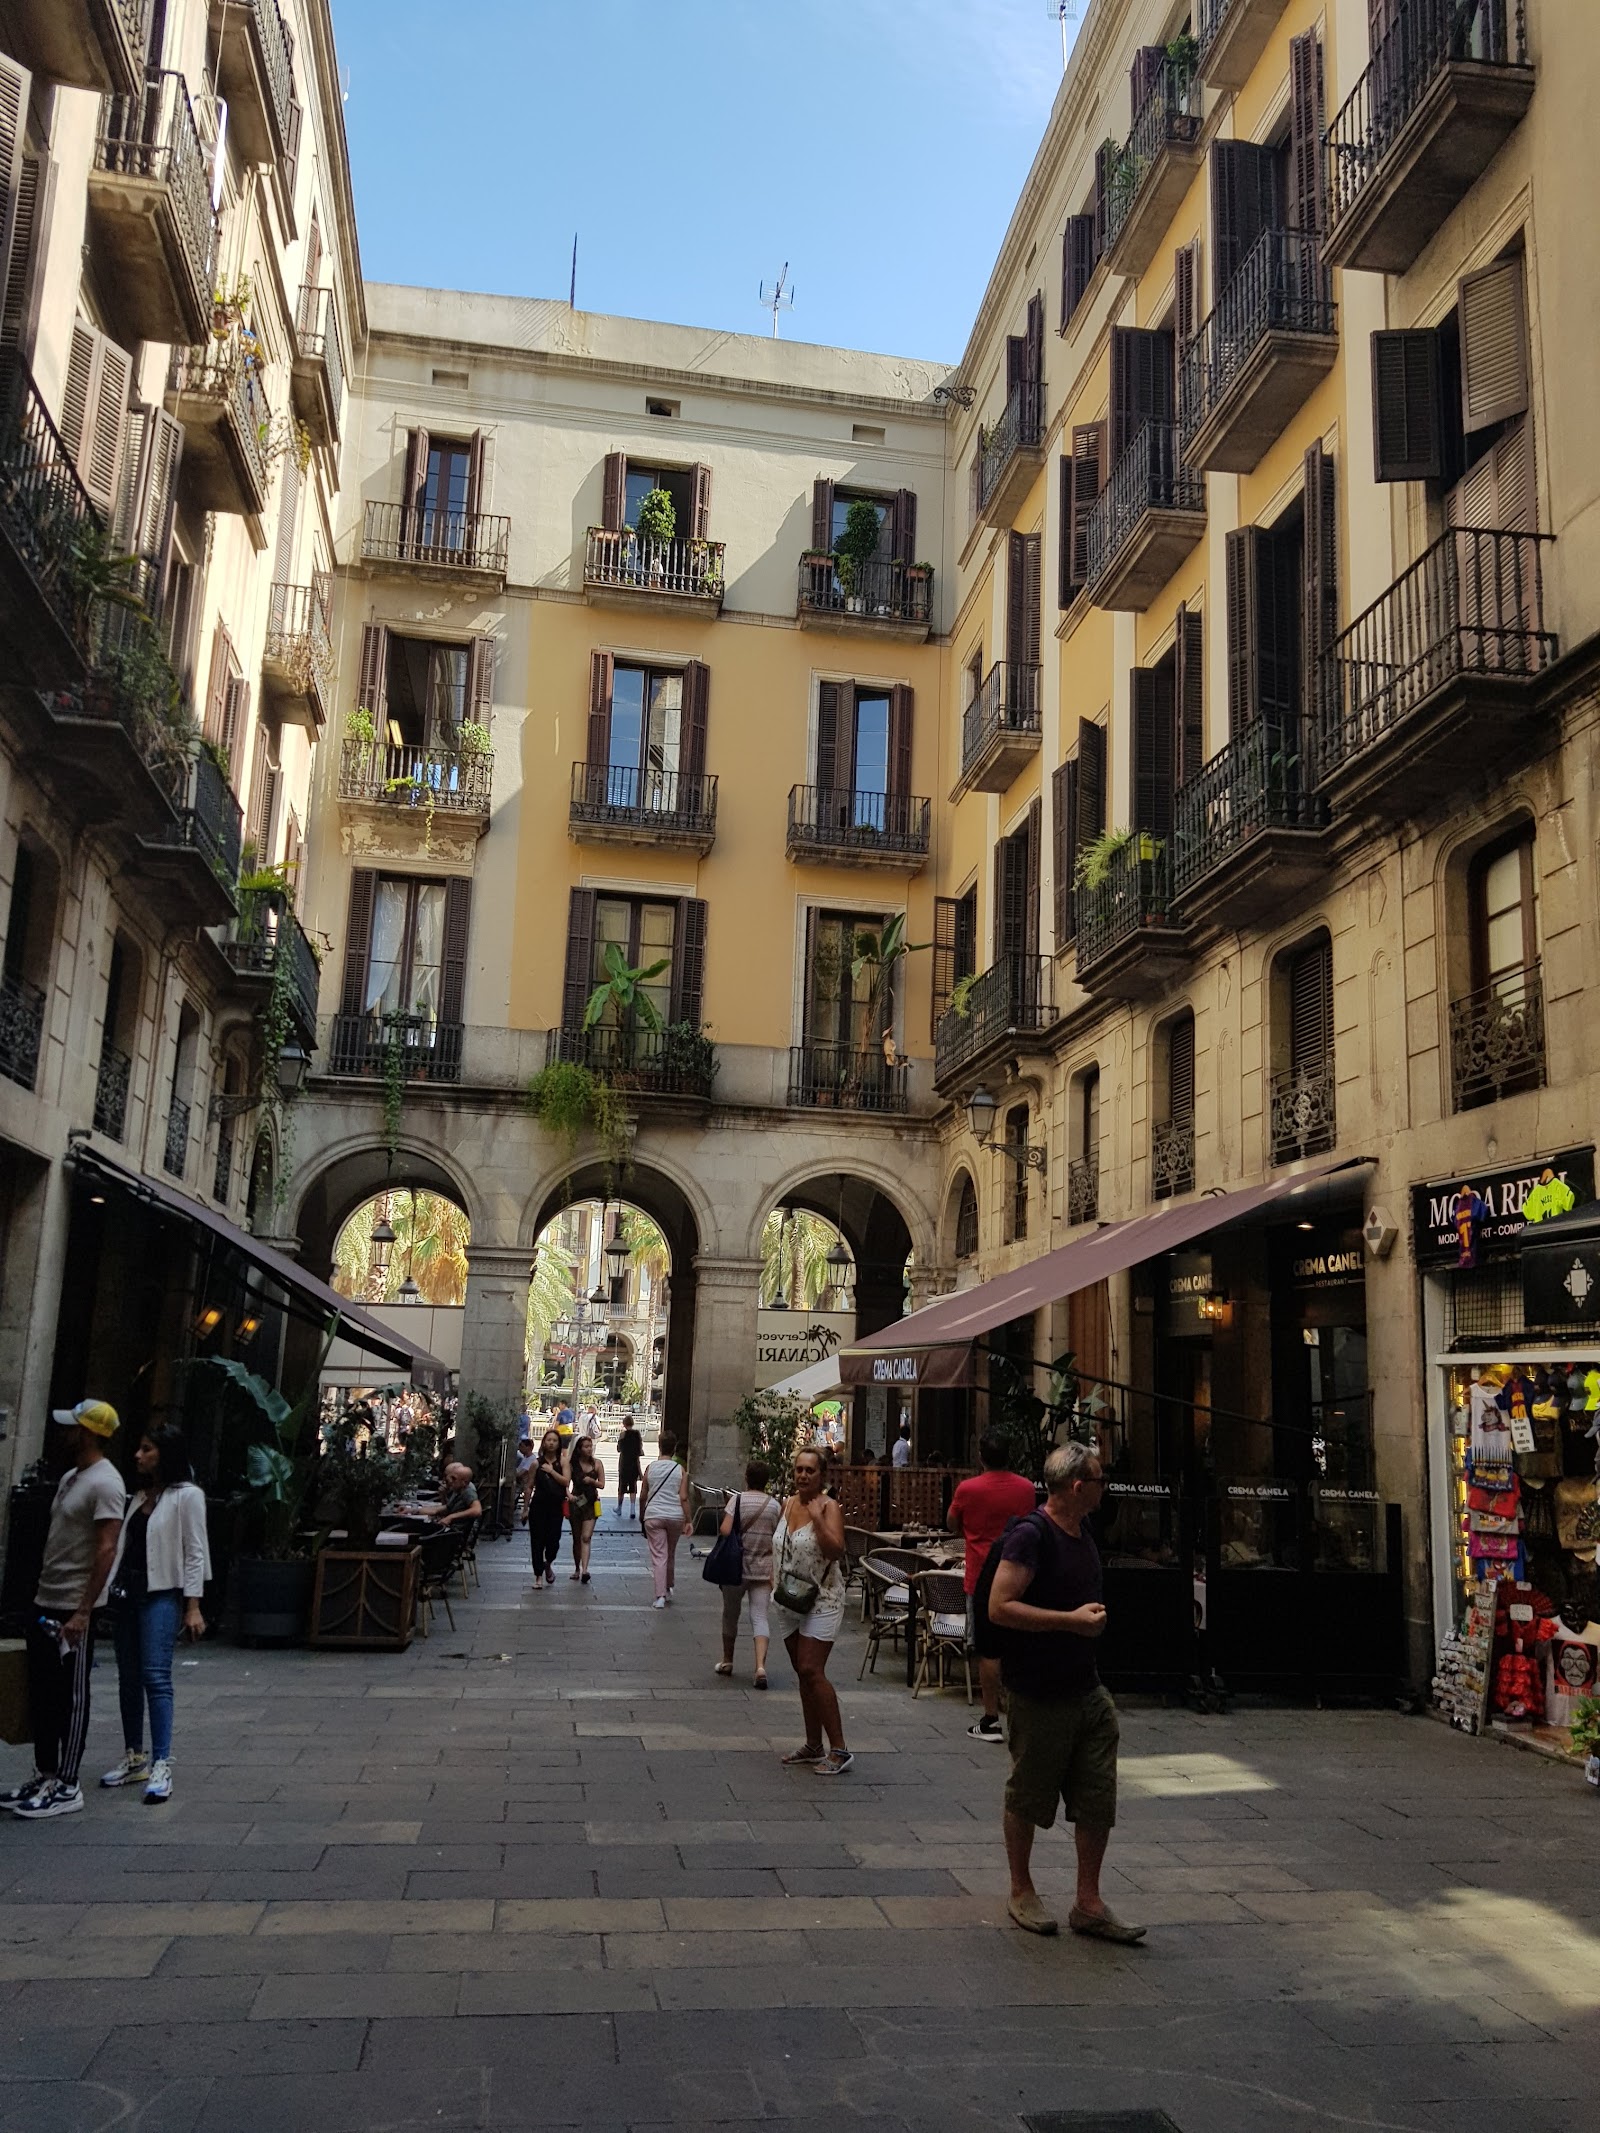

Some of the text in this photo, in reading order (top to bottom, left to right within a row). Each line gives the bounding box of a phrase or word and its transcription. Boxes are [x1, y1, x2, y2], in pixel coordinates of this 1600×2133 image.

[1292, 1251, 1365, 1276] CREMA CANEL
[1315, 1278, 1348, 1288] RESTAURANT
[873, 1357, 917, 1380] CREMA CANELA
[1108, 1483, 1171, 1494] CREMA CANELA
[1227, 1486, 1289, 1496] CREMA CANELA
[1320, 1489, 1380, 1499] CREMA CANELA
